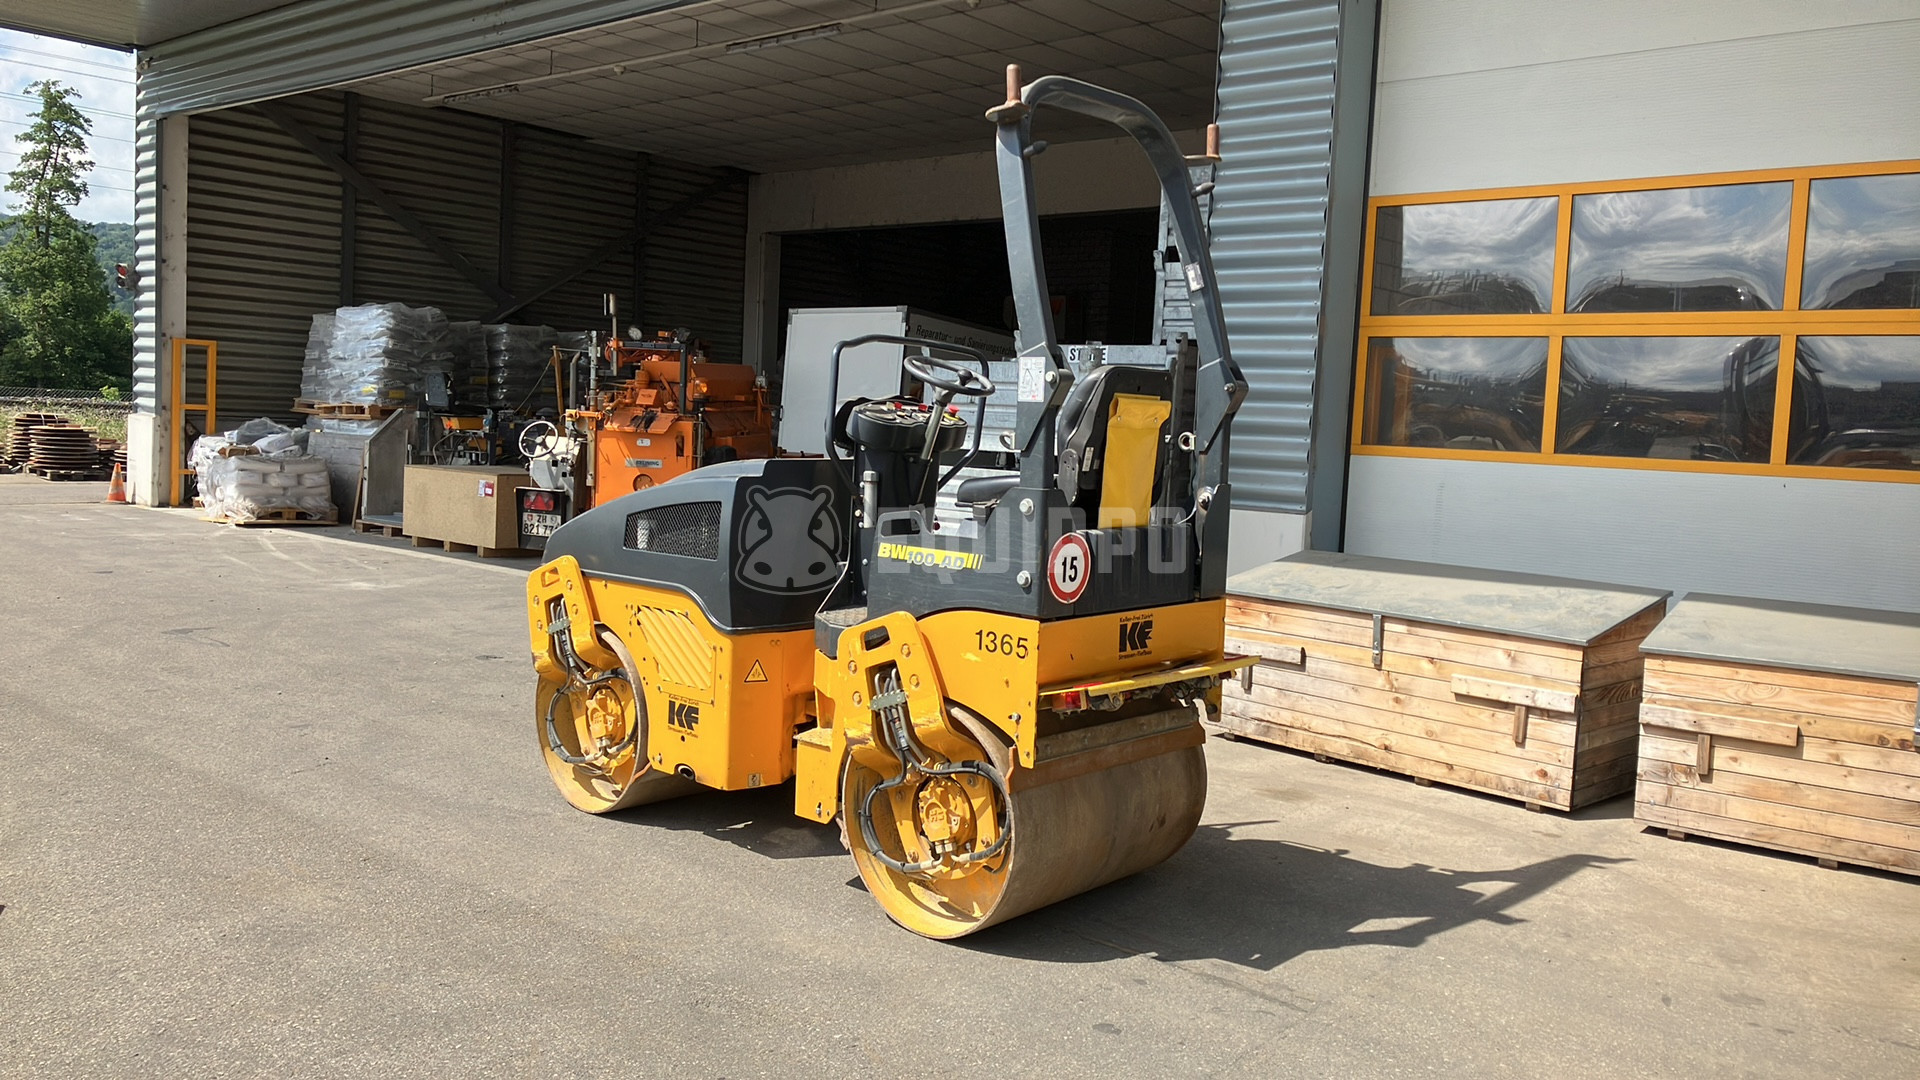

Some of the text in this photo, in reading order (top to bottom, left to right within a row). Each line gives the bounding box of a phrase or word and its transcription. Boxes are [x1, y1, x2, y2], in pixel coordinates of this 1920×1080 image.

[916, 325, 952, 342] Reparatur-
[954, 335, 967, 346] und
[536, 514, 547, 524] ZH
[1061, 556, 1078, 583] 15
[975, 629, 1029, 659] 1365
